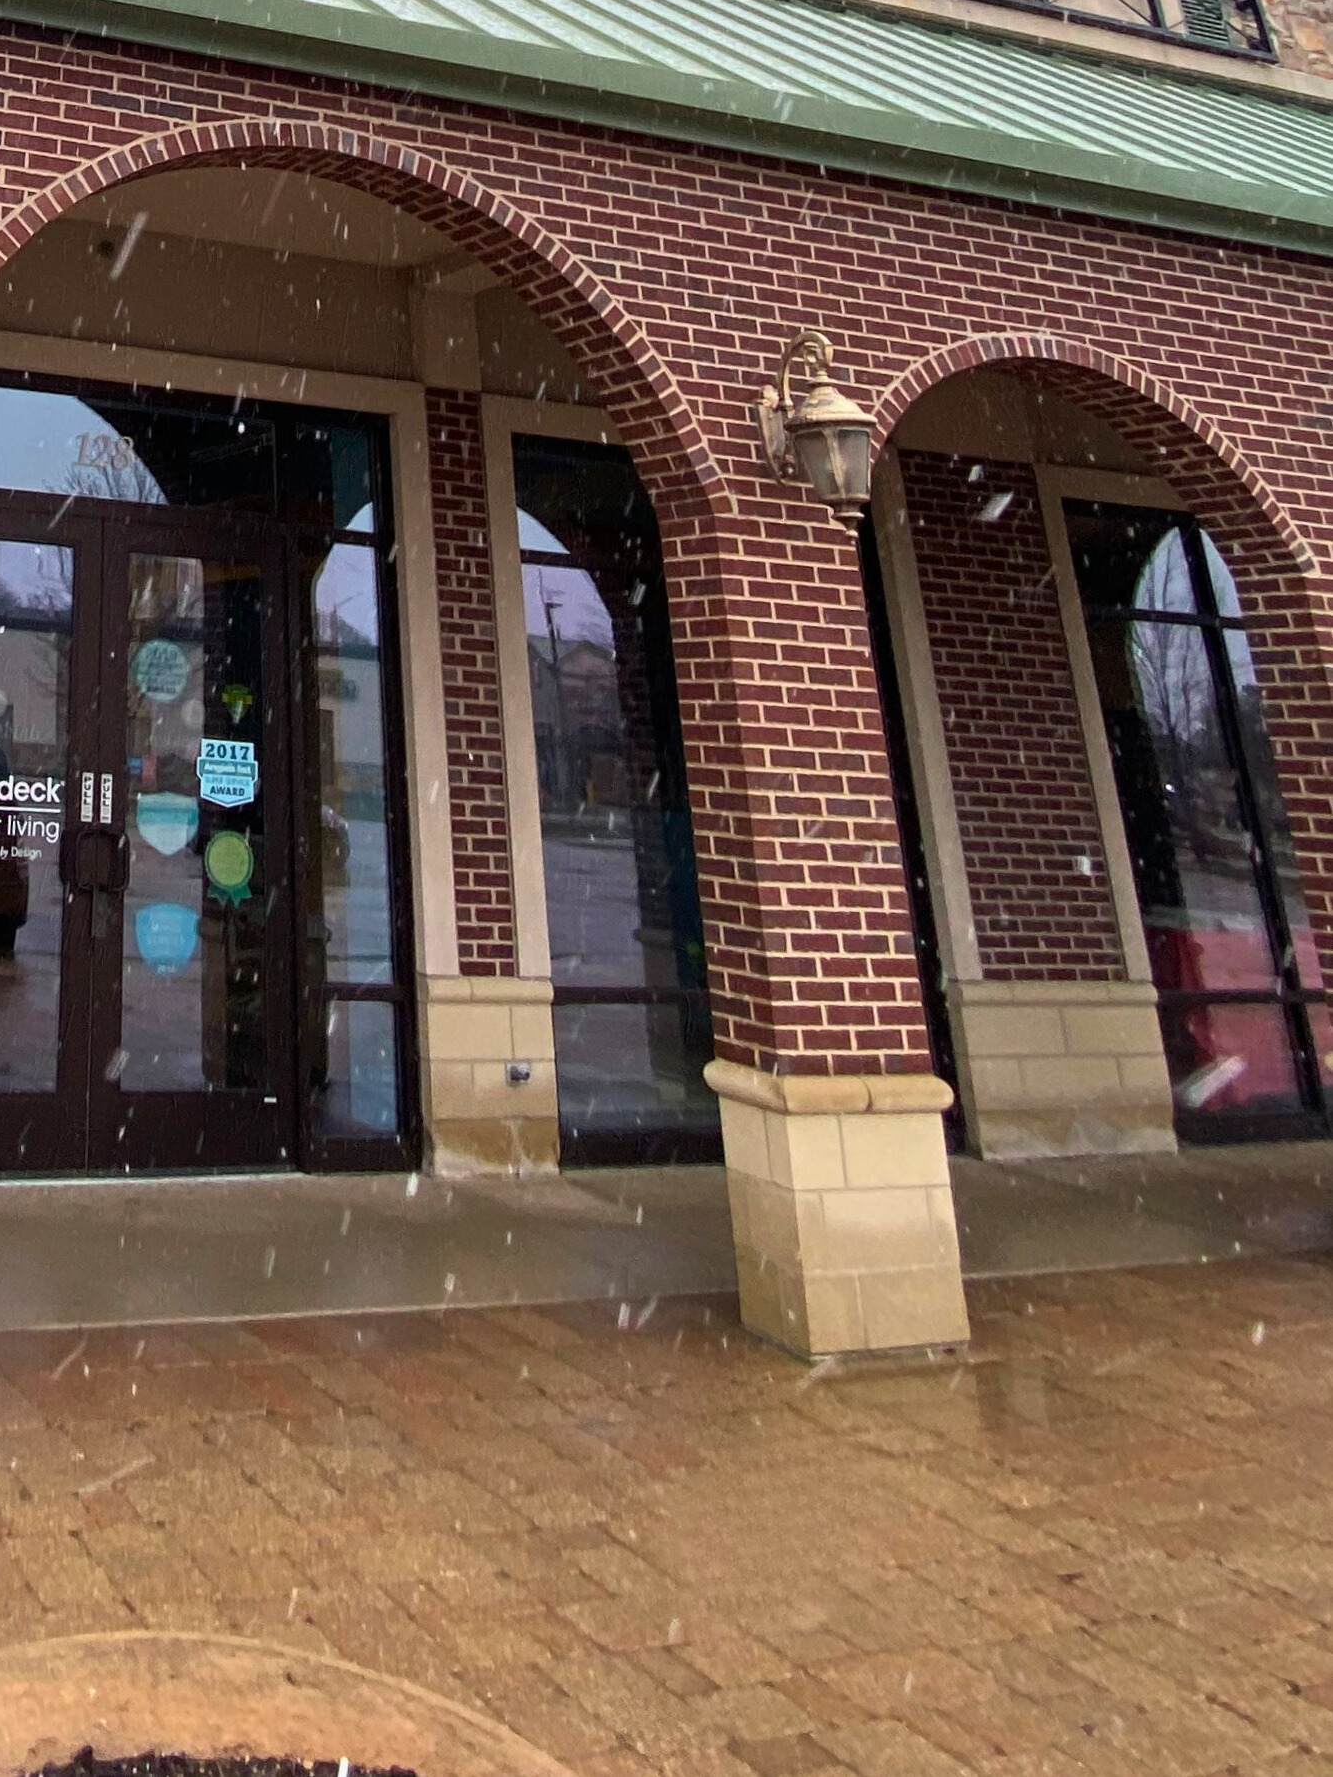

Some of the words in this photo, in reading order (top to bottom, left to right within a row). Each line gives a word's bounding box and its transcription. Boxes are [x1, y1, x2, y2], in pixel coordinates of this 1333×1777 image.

[71, 432, 134, 470] 128
[205, 743, 250, 761] 2017
[83, 776, 92, 806] PULL
[102, 778, 111, 807] PULL
[7, 814, 60, 843] living
[0, 846, 9, 860] by
[11, 846, 42, 860] Design
